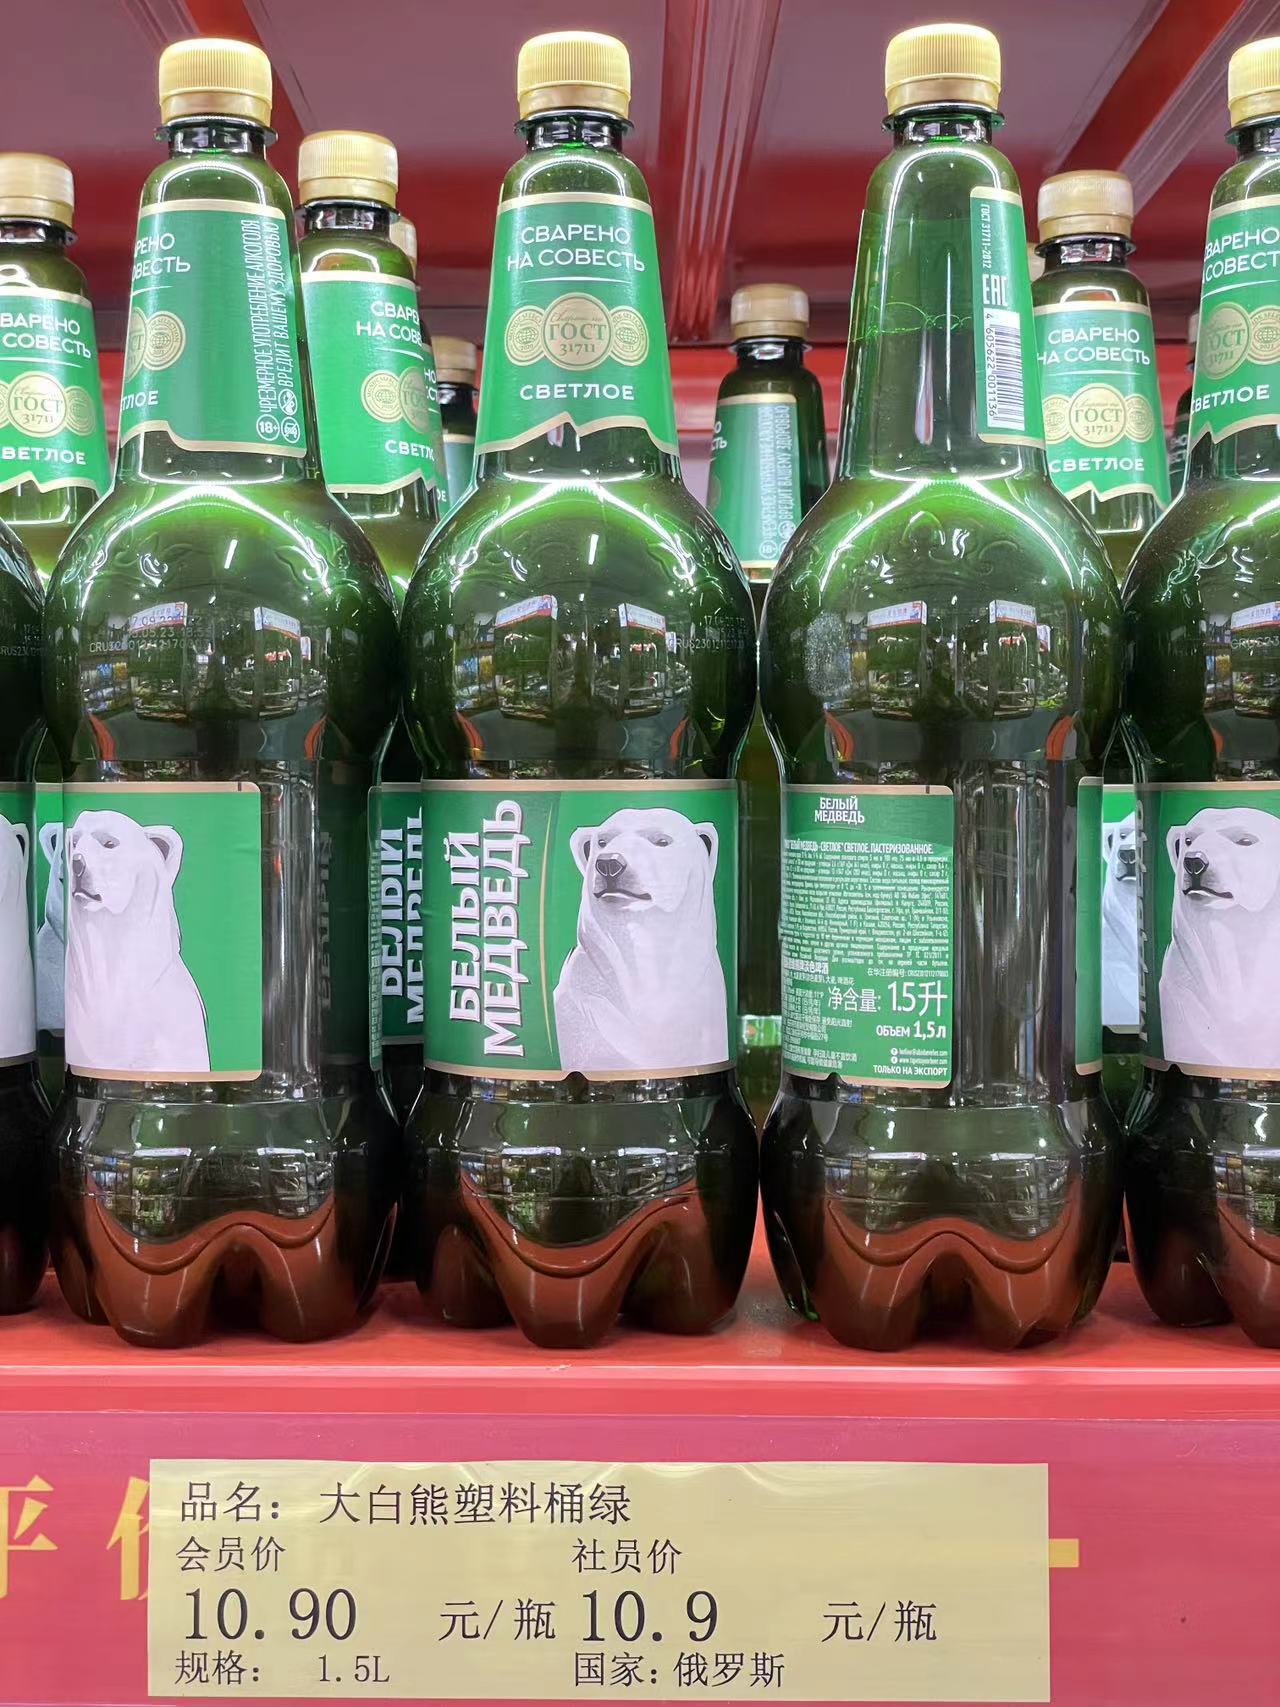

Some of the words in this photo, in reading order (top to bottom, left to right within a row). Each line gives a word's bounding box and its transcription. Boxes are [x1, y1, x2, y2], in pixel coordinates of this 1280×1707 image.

[241, 219, 264, 271] АЛКОГОЛЯ
[521, 224, 631, 245] СВАРЕНО
[982, 223, 992, 269] 31711-2012
[262, 222, 285, 288] ЗДОРОВЬЮ
[507, 255, 534, 272] НА
[538, 248, 645, 272] СОВЕСТЬ
[246, 272, 273, 348] УПОТРЕБЛЕНИЕ
[269, 289, 289, 340] ВАШЕМУ
[371, 301, 419, 326] СВАРЕ
[356, 321, 386, 337] НА
[549, 322, 607, 341] ГОСТ
[1048, 327, 1140, 344] СВАРЕНО
[1208, 328, 1246, 349] ОСТ
[2, 333, 91, 359] СОВЕСТЬ
[560, 344, 595, 357] 31711
[985, 327, 996, 369] 605622
[1064, 347, 1150, 365] СОВЕСТЬ
[274, 340, 294, 388] ВРЕДИТ
[519, 383, 635, 401] СВЕТЛОЕ
[987, 374, 997, 416] 001136
[14, 396, 64, 414] ГОСТ
[1074, 408, 1122, 423] ГОСТ
[22, 412, 54, 425] 31711
[258, 421, 279, 434] 18+
[1083, 425, 1114, 435] 31711
[1050, 457, 1145, 473] СВЕТЛОЕ
[820, 795, 858, 810] БЕЛЫЙ
[814, 810, 865, 824] МЕДВЕДЬ
[444, 832, 480, 1022] БЕЛЫЙ
[483, 800, 531, 1056] МЕДВЕДЬ
[828, 986, 881, 1013] 净含量:
[887, 980, 948, 1017] 1.5升
[876, 1024, 911, 1037] ОБЪЕМ
[873, 1064, 901, 1074] ТОЛЬКО
[902, 1066, 913, 1075] НА
[914, 1066, 948, 1076] ЭКСПОРТ
[181, 1481, 280, 1521] 品名：
[319, 1481, 631, 1526] 大白熊塑料桶绿
[175, 1536, 286, 1573] 会员价
[572, 1538, 682, 1575] 社员价
[184, 1588, 357, 1641] 10.90
[581, 1590, 718, 1643] 10.9
[174, 1651, 262, 1686] 规格：
[318, 1655, 390, 1685] 1.5L
